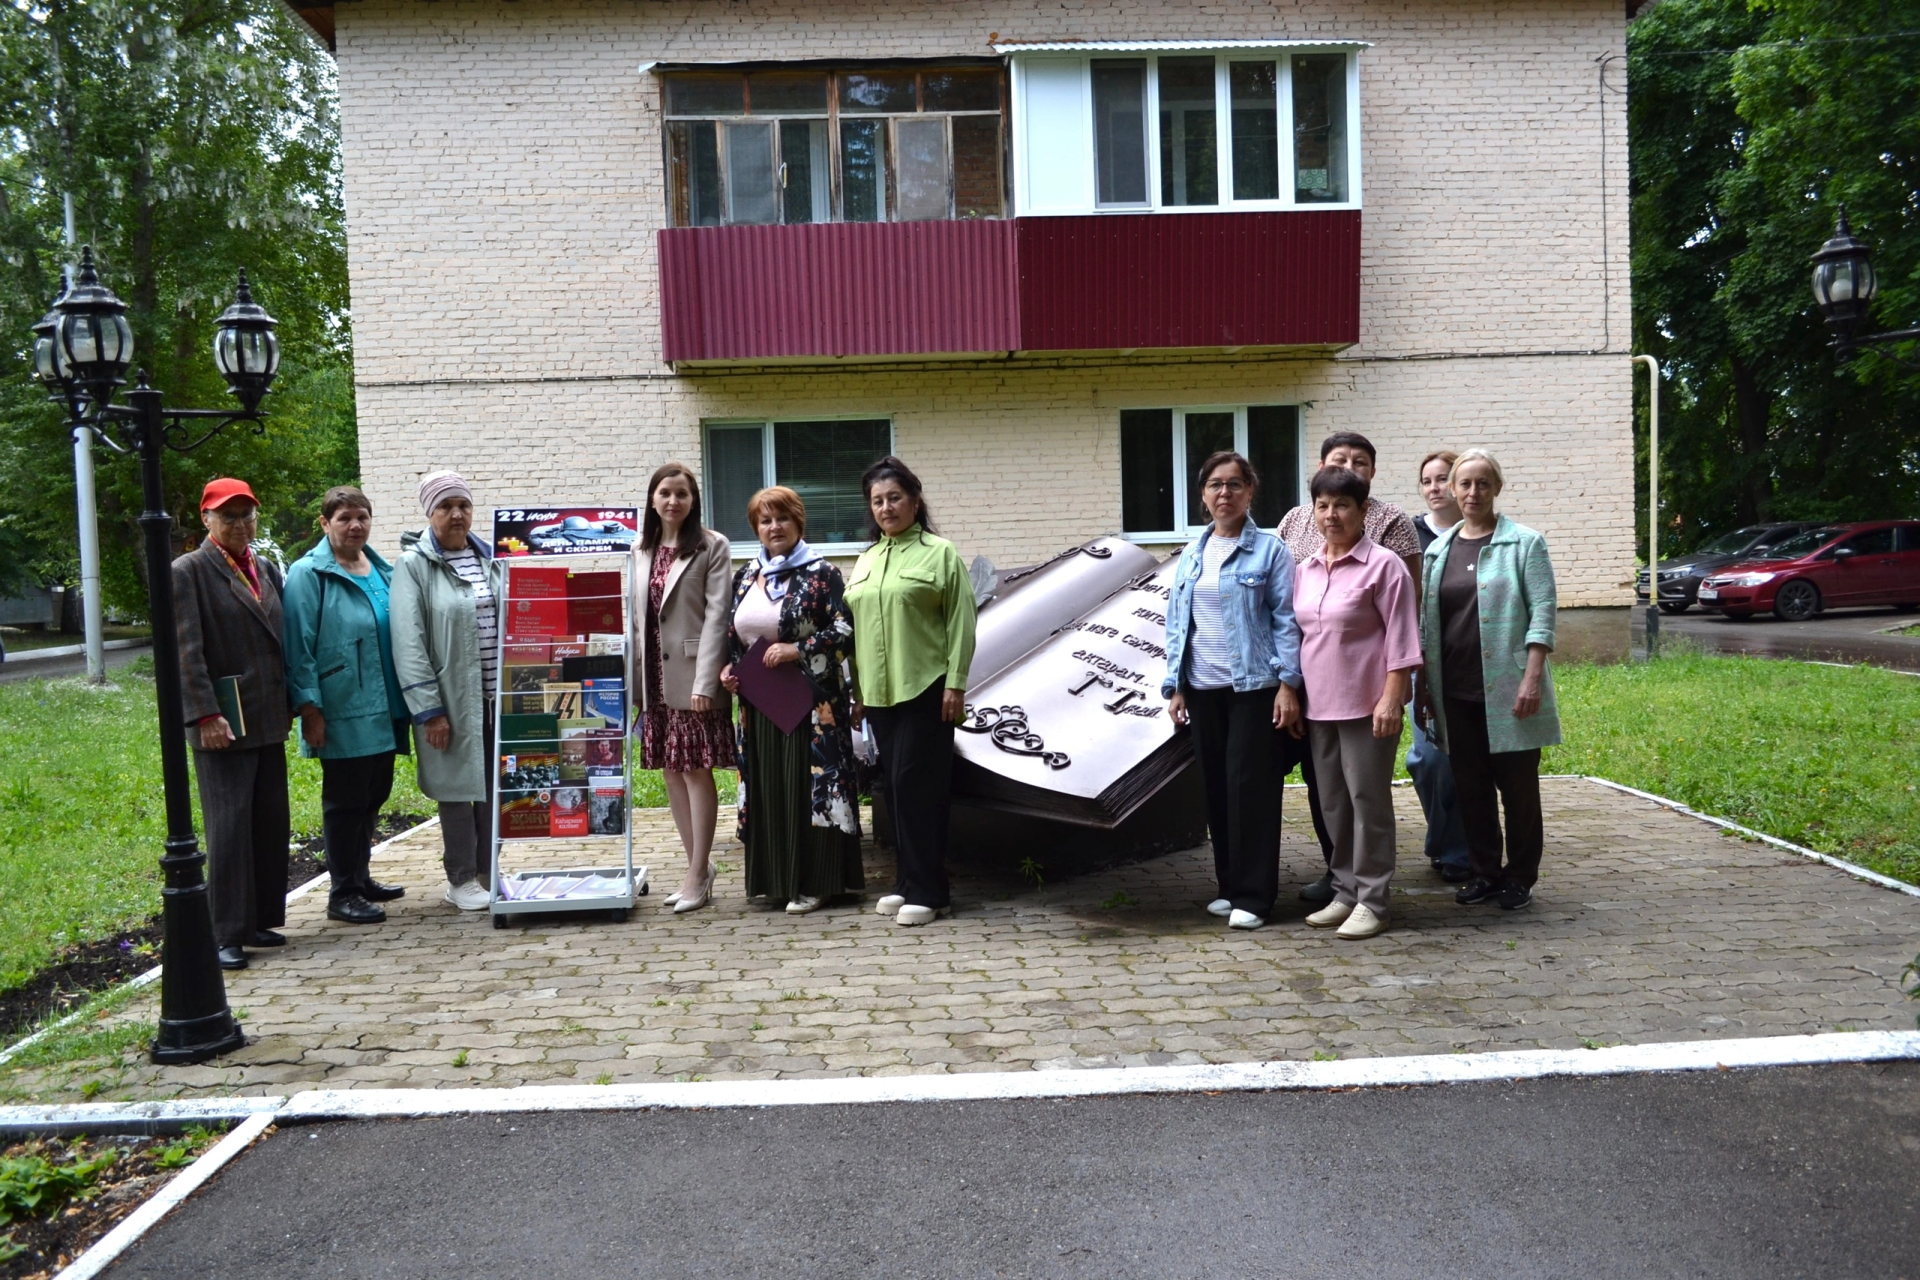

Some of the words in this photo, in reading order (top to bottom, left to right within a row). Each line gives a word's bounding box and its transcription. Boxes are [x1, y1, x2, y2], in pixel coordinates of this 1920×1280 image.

[497, 510, 525, 522] 22
[597, 511, 633, 520] 1941
[541, 540, 574, 549] ДЕНЬ
[575, 538, 625, 546] ПАМЯТИ
[565, 545, 612, 553] СКОРБИ
